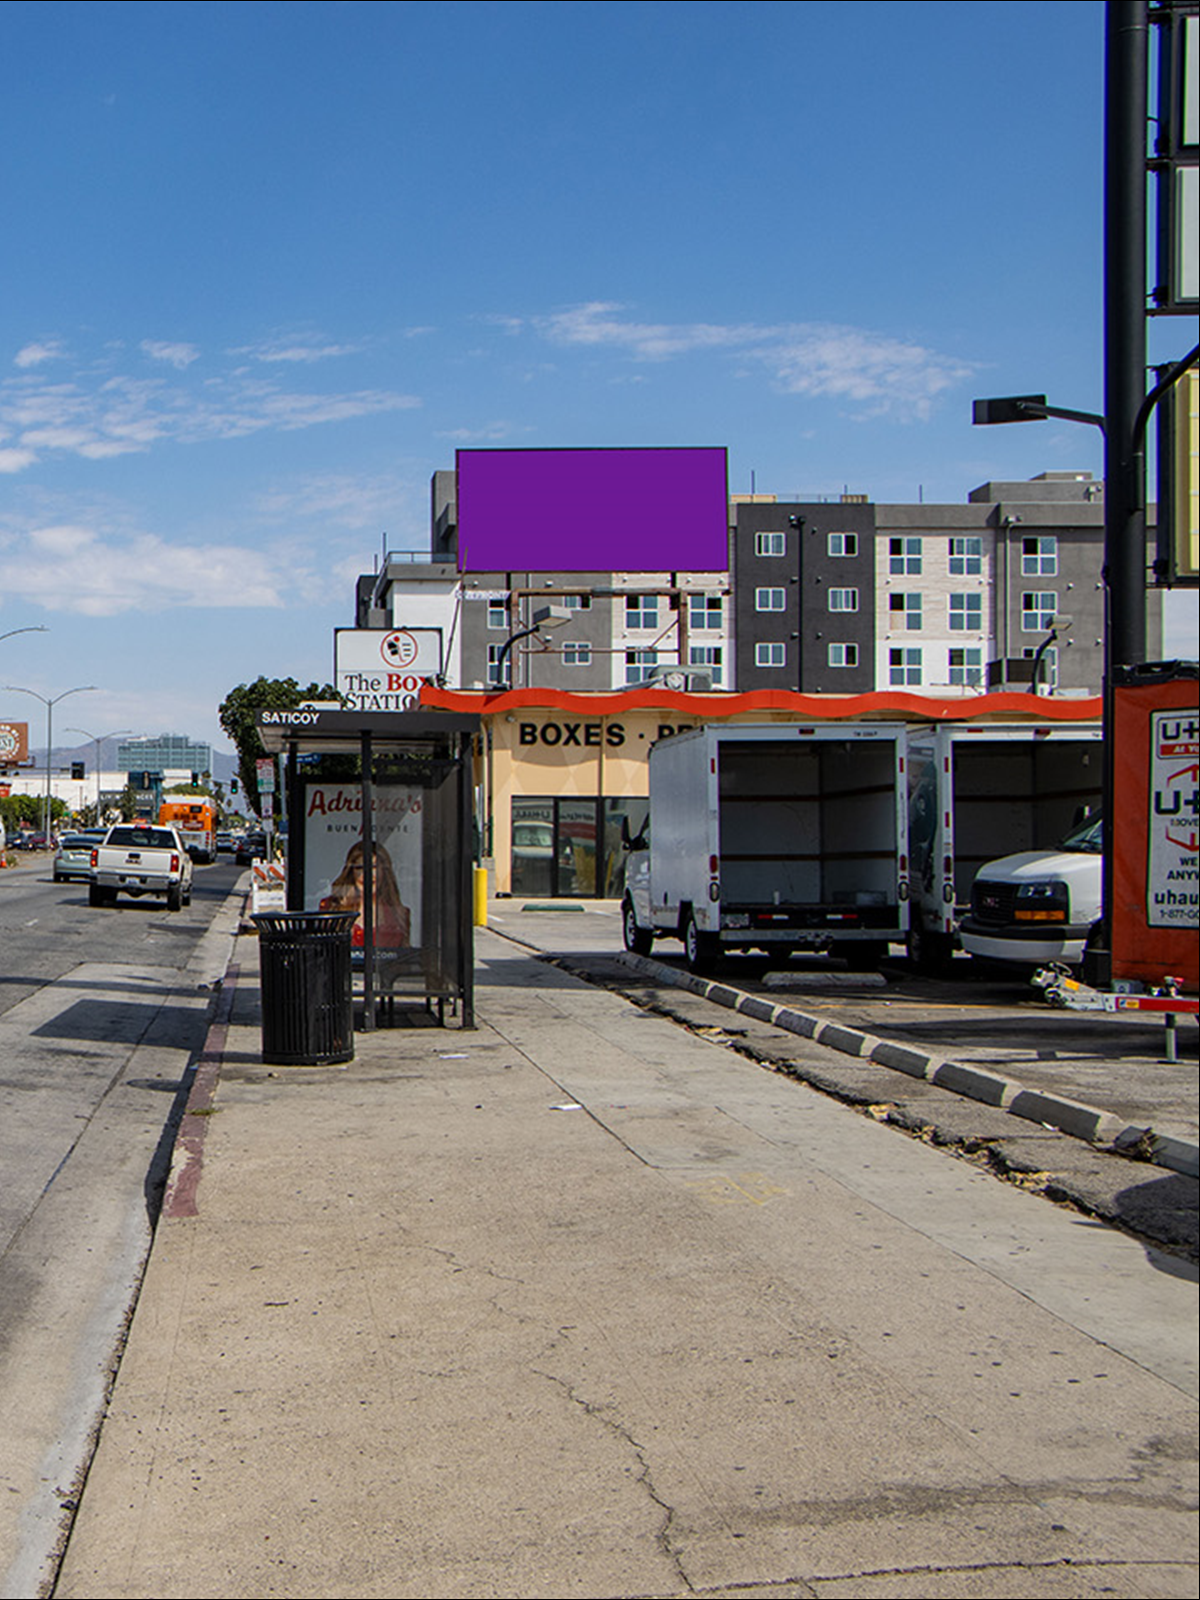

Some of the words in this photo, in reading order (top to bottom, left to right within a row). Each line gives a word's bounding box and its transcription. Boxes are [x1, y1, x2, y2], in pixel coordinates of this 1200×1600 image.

[344, 673, 382, 692] The
[261, 711, 320, 725] SATICOY
[519, 722, 626, 747] BOXES
[1179, 857, 1199, 867] WE
